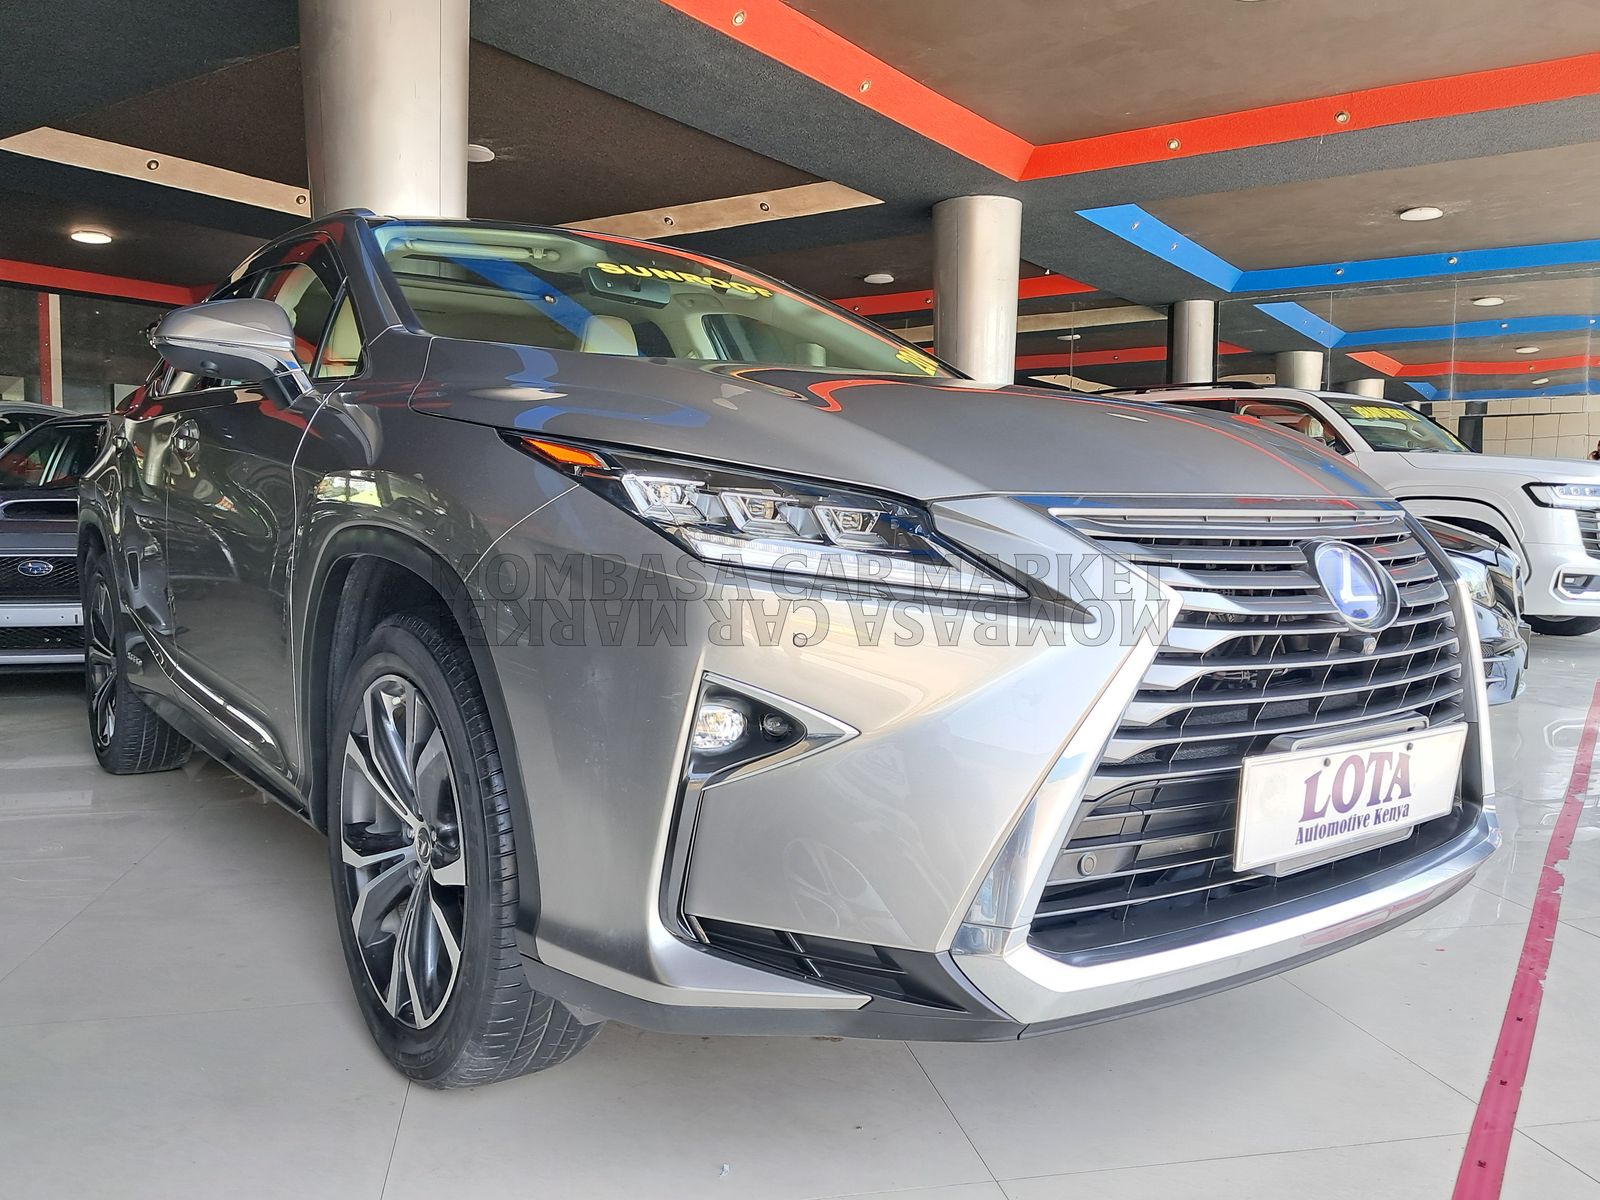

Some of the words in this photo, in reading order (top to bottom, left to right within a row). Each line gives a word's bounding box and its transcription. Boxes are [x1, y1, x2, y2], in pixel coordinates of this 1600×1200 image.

[595, 262, 773, 298] SUNROOF
[1298, 752, 1412, 823] LOTA
[1295, 813, 1371, 845] Automotive
[1373, 803, 1410, 826] Kenya
